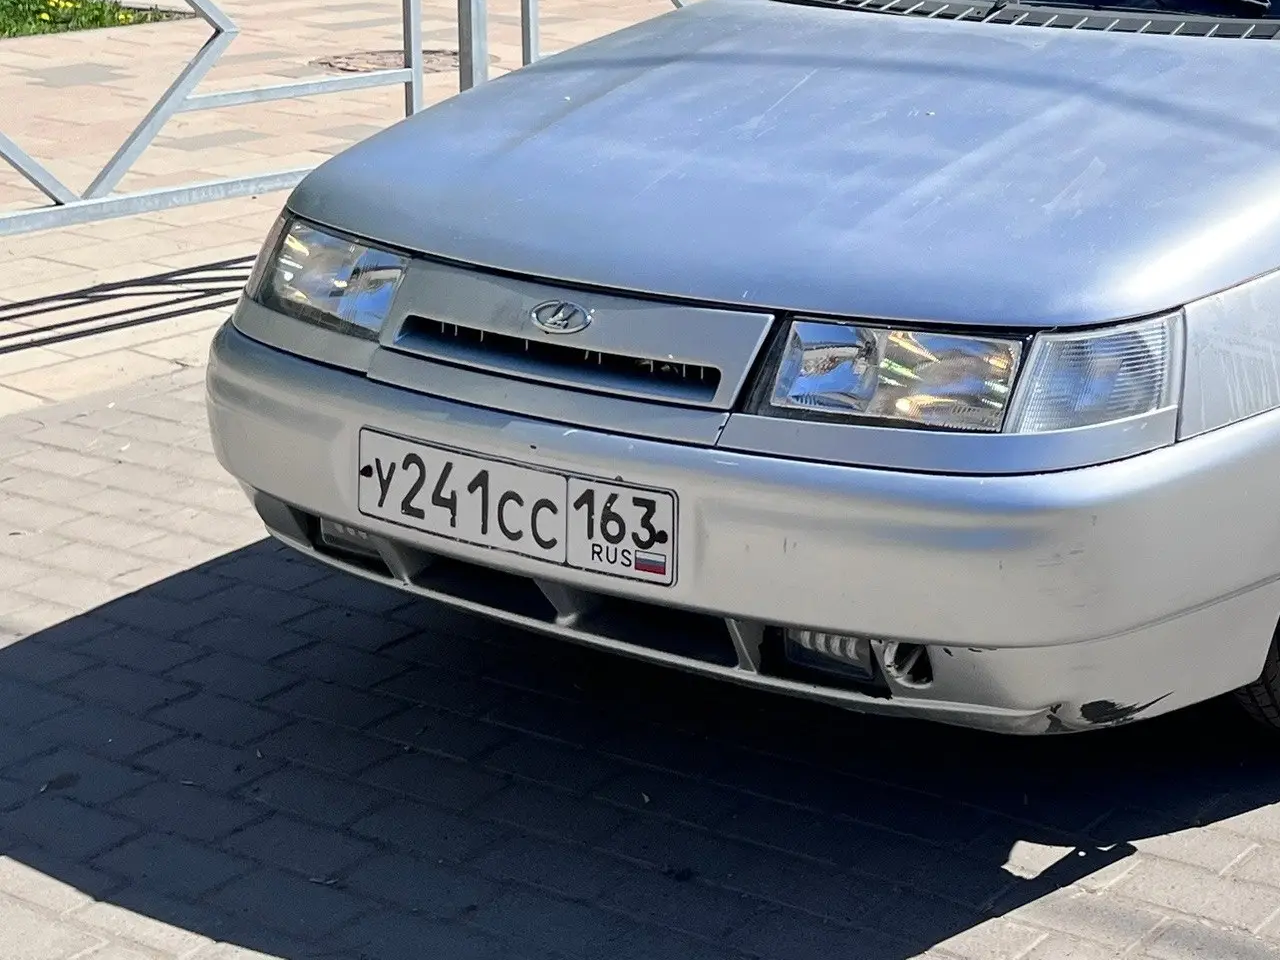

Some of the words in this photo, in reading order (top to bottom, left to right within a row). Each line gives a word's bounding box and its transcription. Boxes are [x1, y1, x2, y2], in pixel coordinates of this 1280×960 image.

[374, 452, 559, 550] У241СС
[572, 488, 659, 551] 163
[591, 543, 633, 568] RUS
